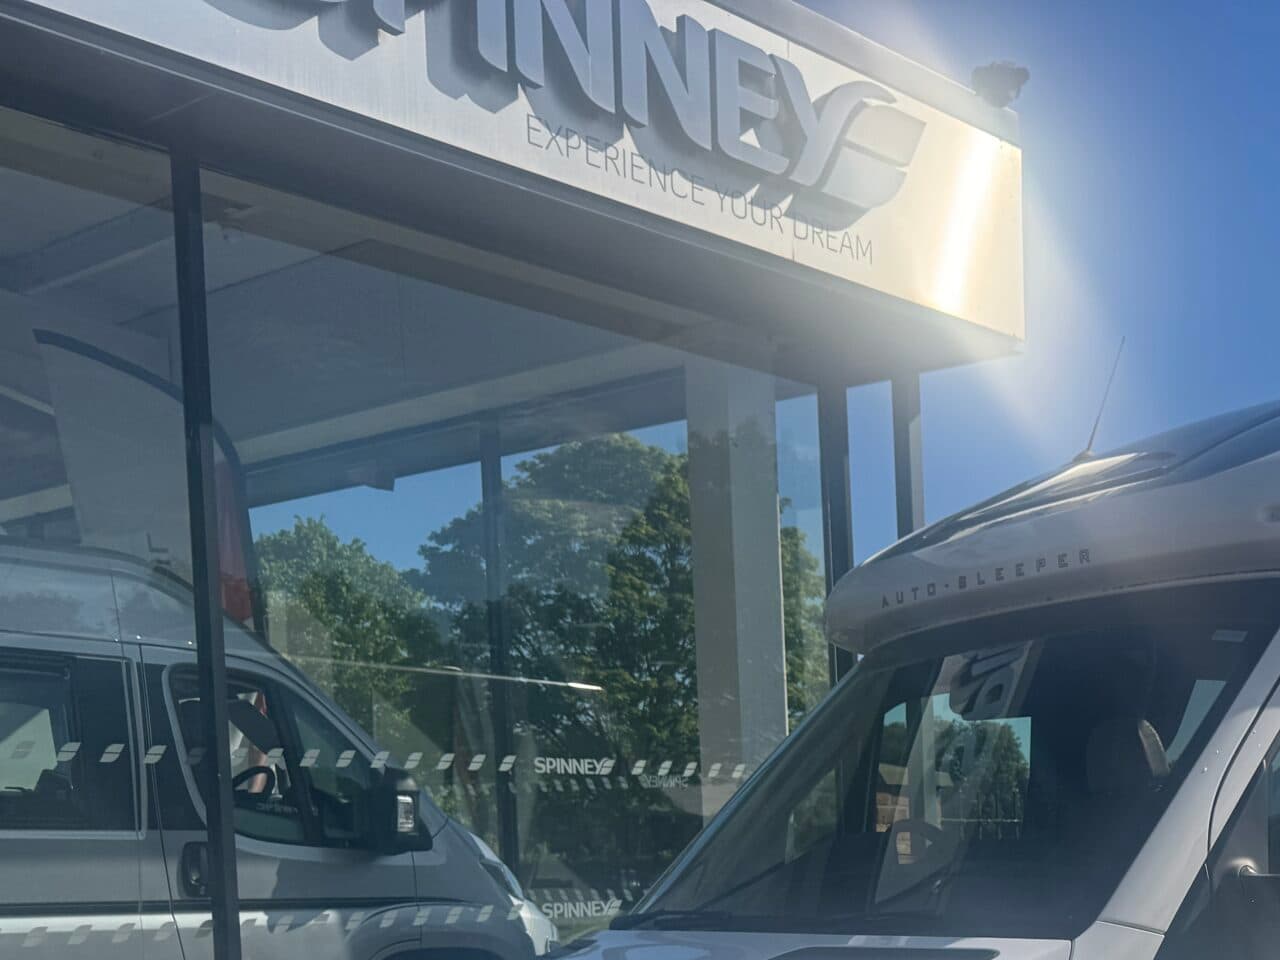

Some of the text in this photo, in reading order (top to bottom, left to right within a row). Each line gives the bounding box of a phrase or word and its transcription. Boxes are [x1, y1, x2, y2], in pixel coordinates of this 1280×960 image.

[526, 112, 873, 265] EXPERIENCE YOUR DREAM
[534, 757, 611, 775] SPINNEY
[541, 900, 616, 919] SPINNEY
